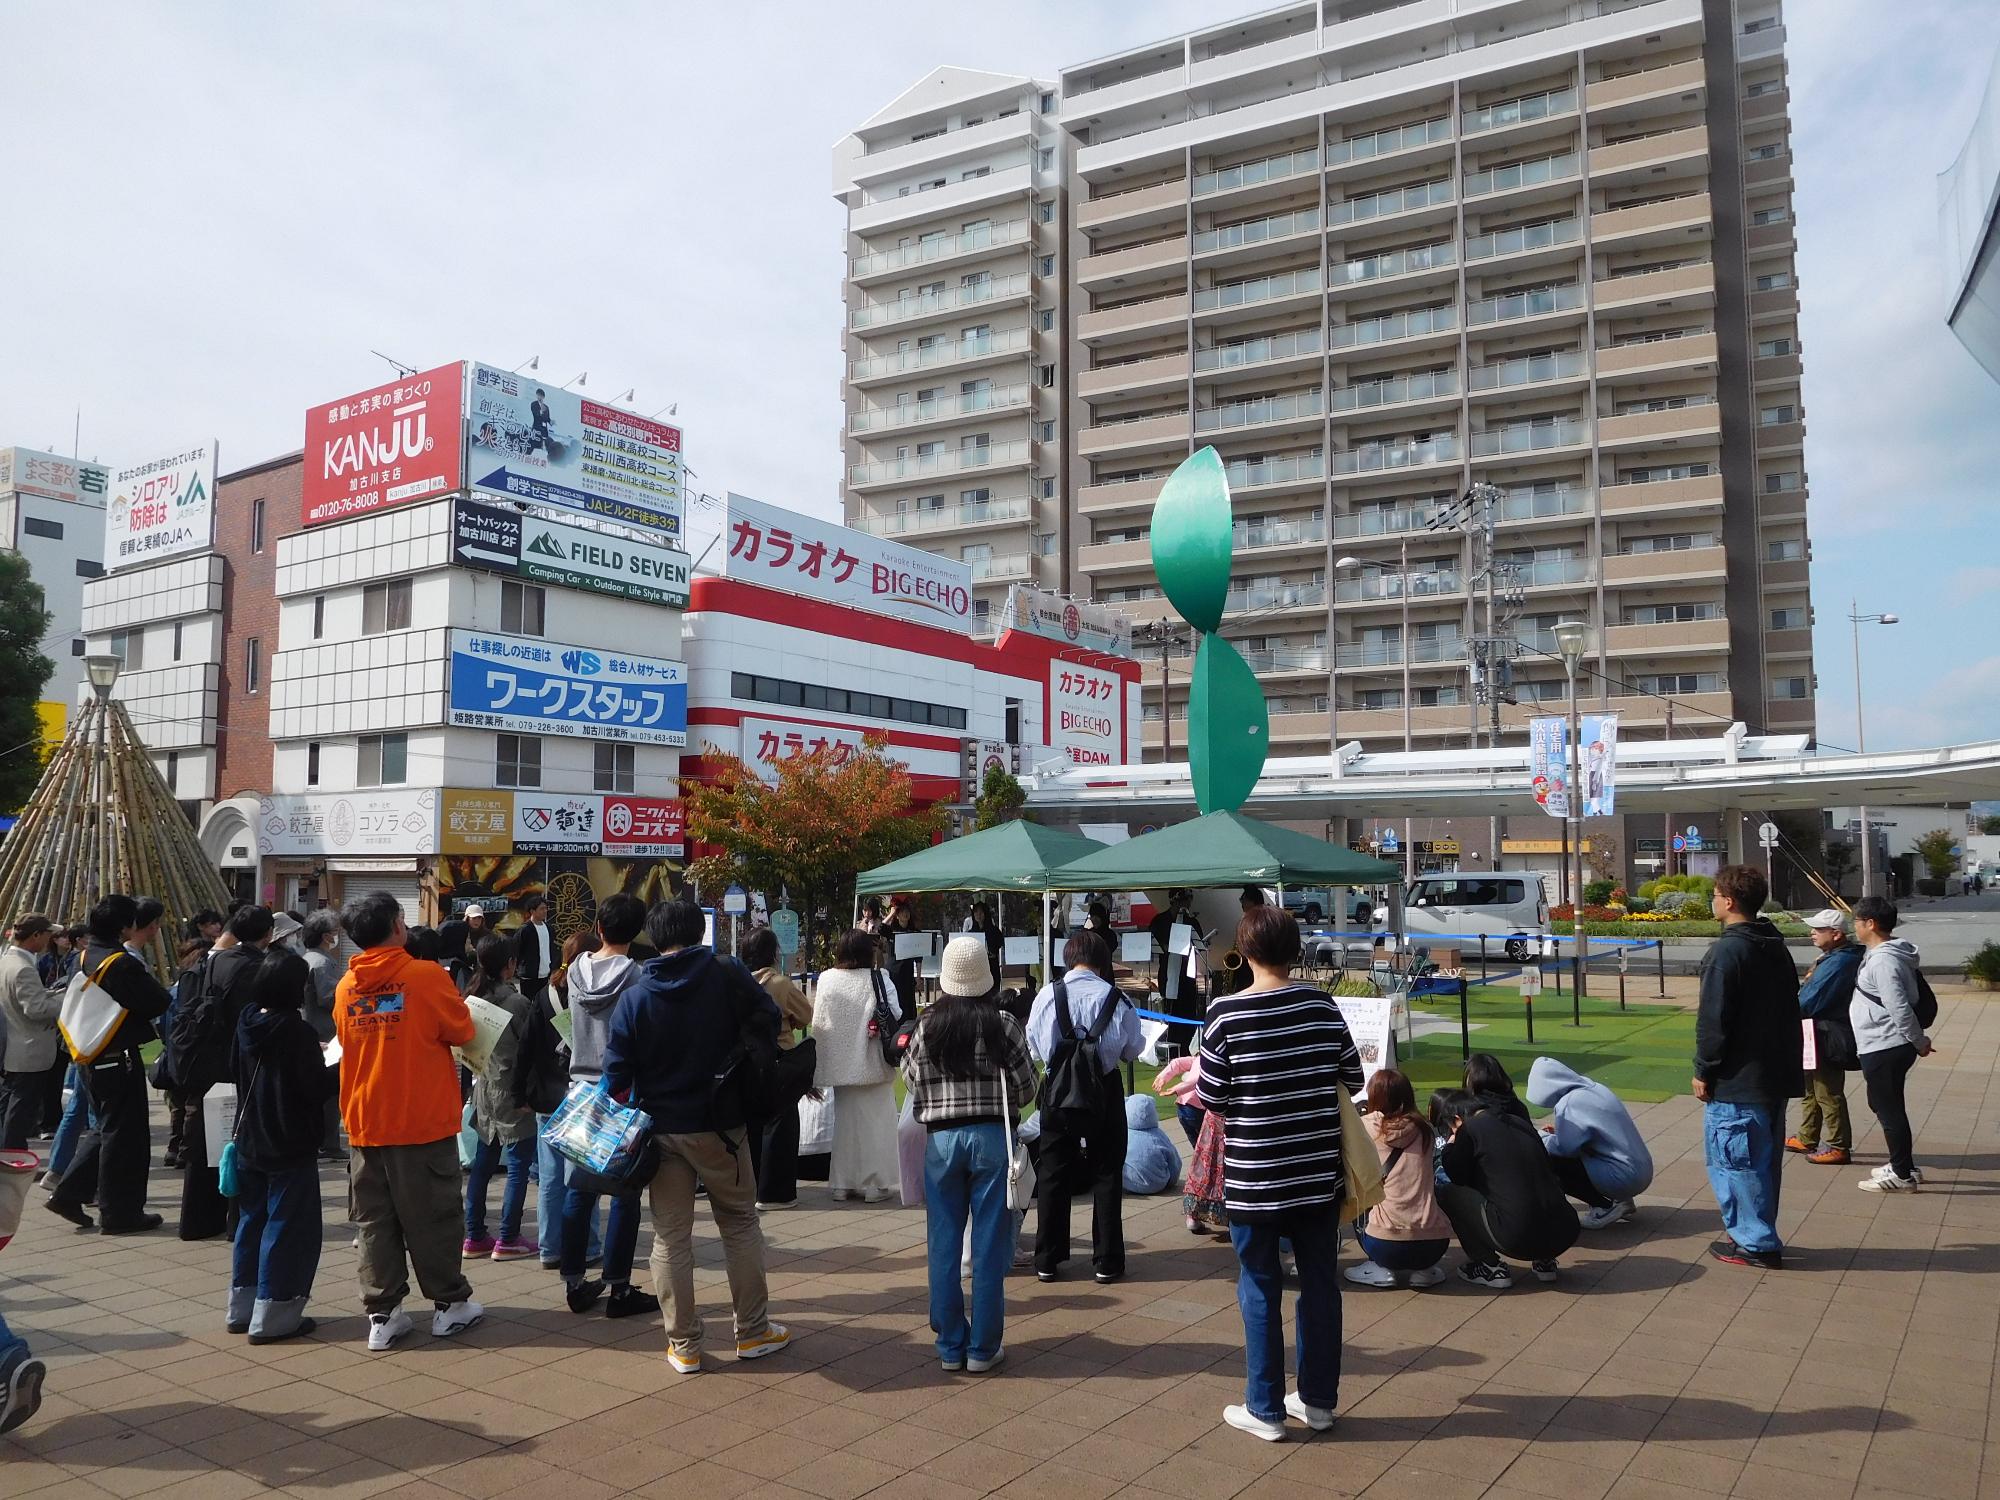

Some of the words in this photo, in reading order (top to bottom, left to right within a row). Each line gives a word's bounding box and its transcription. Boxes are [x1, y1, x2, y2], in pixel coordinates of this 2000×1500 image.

[477, 368, 518, 393] 創学ゼミ
[328, 380, 432, 424] 感動と充実の家づくり
[488, 415, 542, 442] キミの心に
[582, 428, 677, 466] 加古川東高校コース
[582, 445, 677, 482] 加古川西高校コース
[79, 467, 109, 494] 若
[131, 471, 181, 506] シロアリ
[349, 467, 403, 491] 加古川支店
[506, 476, 549, 499] 創学ゼミ
[129, 501, 168, 532] 防除は
[318, 491, 379, 518] 0120-76-8008
[586, 498, 676, 531] JAビル2F徒歩3分
[457, 511, 520, 535] オートバックス
[119, 528, 193, 557] 信頼と実績のJAへ
[458, 525, 500, 545] 加古川店
[501, 535, 518, 549] 2F
[571, 541, 624, 570] FIELD
[629, 555, 687, 584] SEVEN
[729, 519, 861, 584] カラオケ
[881, 551, 910, 568] Karaoke
[912, 560, 961, 581] Entertainment
[528, 565, 565, 583] Camping
[567, 572, 582, 584] Car
[593, 578, 625, 594] Outdoor
[628, 585, 642, 597] Life
[643, 588, 661, 601] Style
[662, 592, 684, 605] 専門店
[872, 563, 911, 595] BIG
[915, 577, 970, 616] ECHO
[469, 638, 552, 663] 仕事探しの近道は
[560, 650, 602, 676] WS
[608, 658, 678, 680] 総合人材サービス
[486, 670, 665, 725] ワークスタッフ
[1059, 670, 1113, 702] カラオケ
[454, 711, 504, 728] 姫路営業所
[518, 721, 574, 734] 079-226-3600
[582, 724, 629, 740] 加古川営業所
[1060, 710, 1081, 731] BIG
[1083, 716, 1112, 737] ECHO
[289, 815, 325, 834] 餃子屋
[359, 814, 400, 832] コソラ
[448, 811, 507, 832] 餃子屋
[608, 805, 631, 835] 肉
[635, 805, 684, 819] ニクバル
[633, 818, 680, 837] コズチ
[350, 1014, 402, 1028] JEANS
